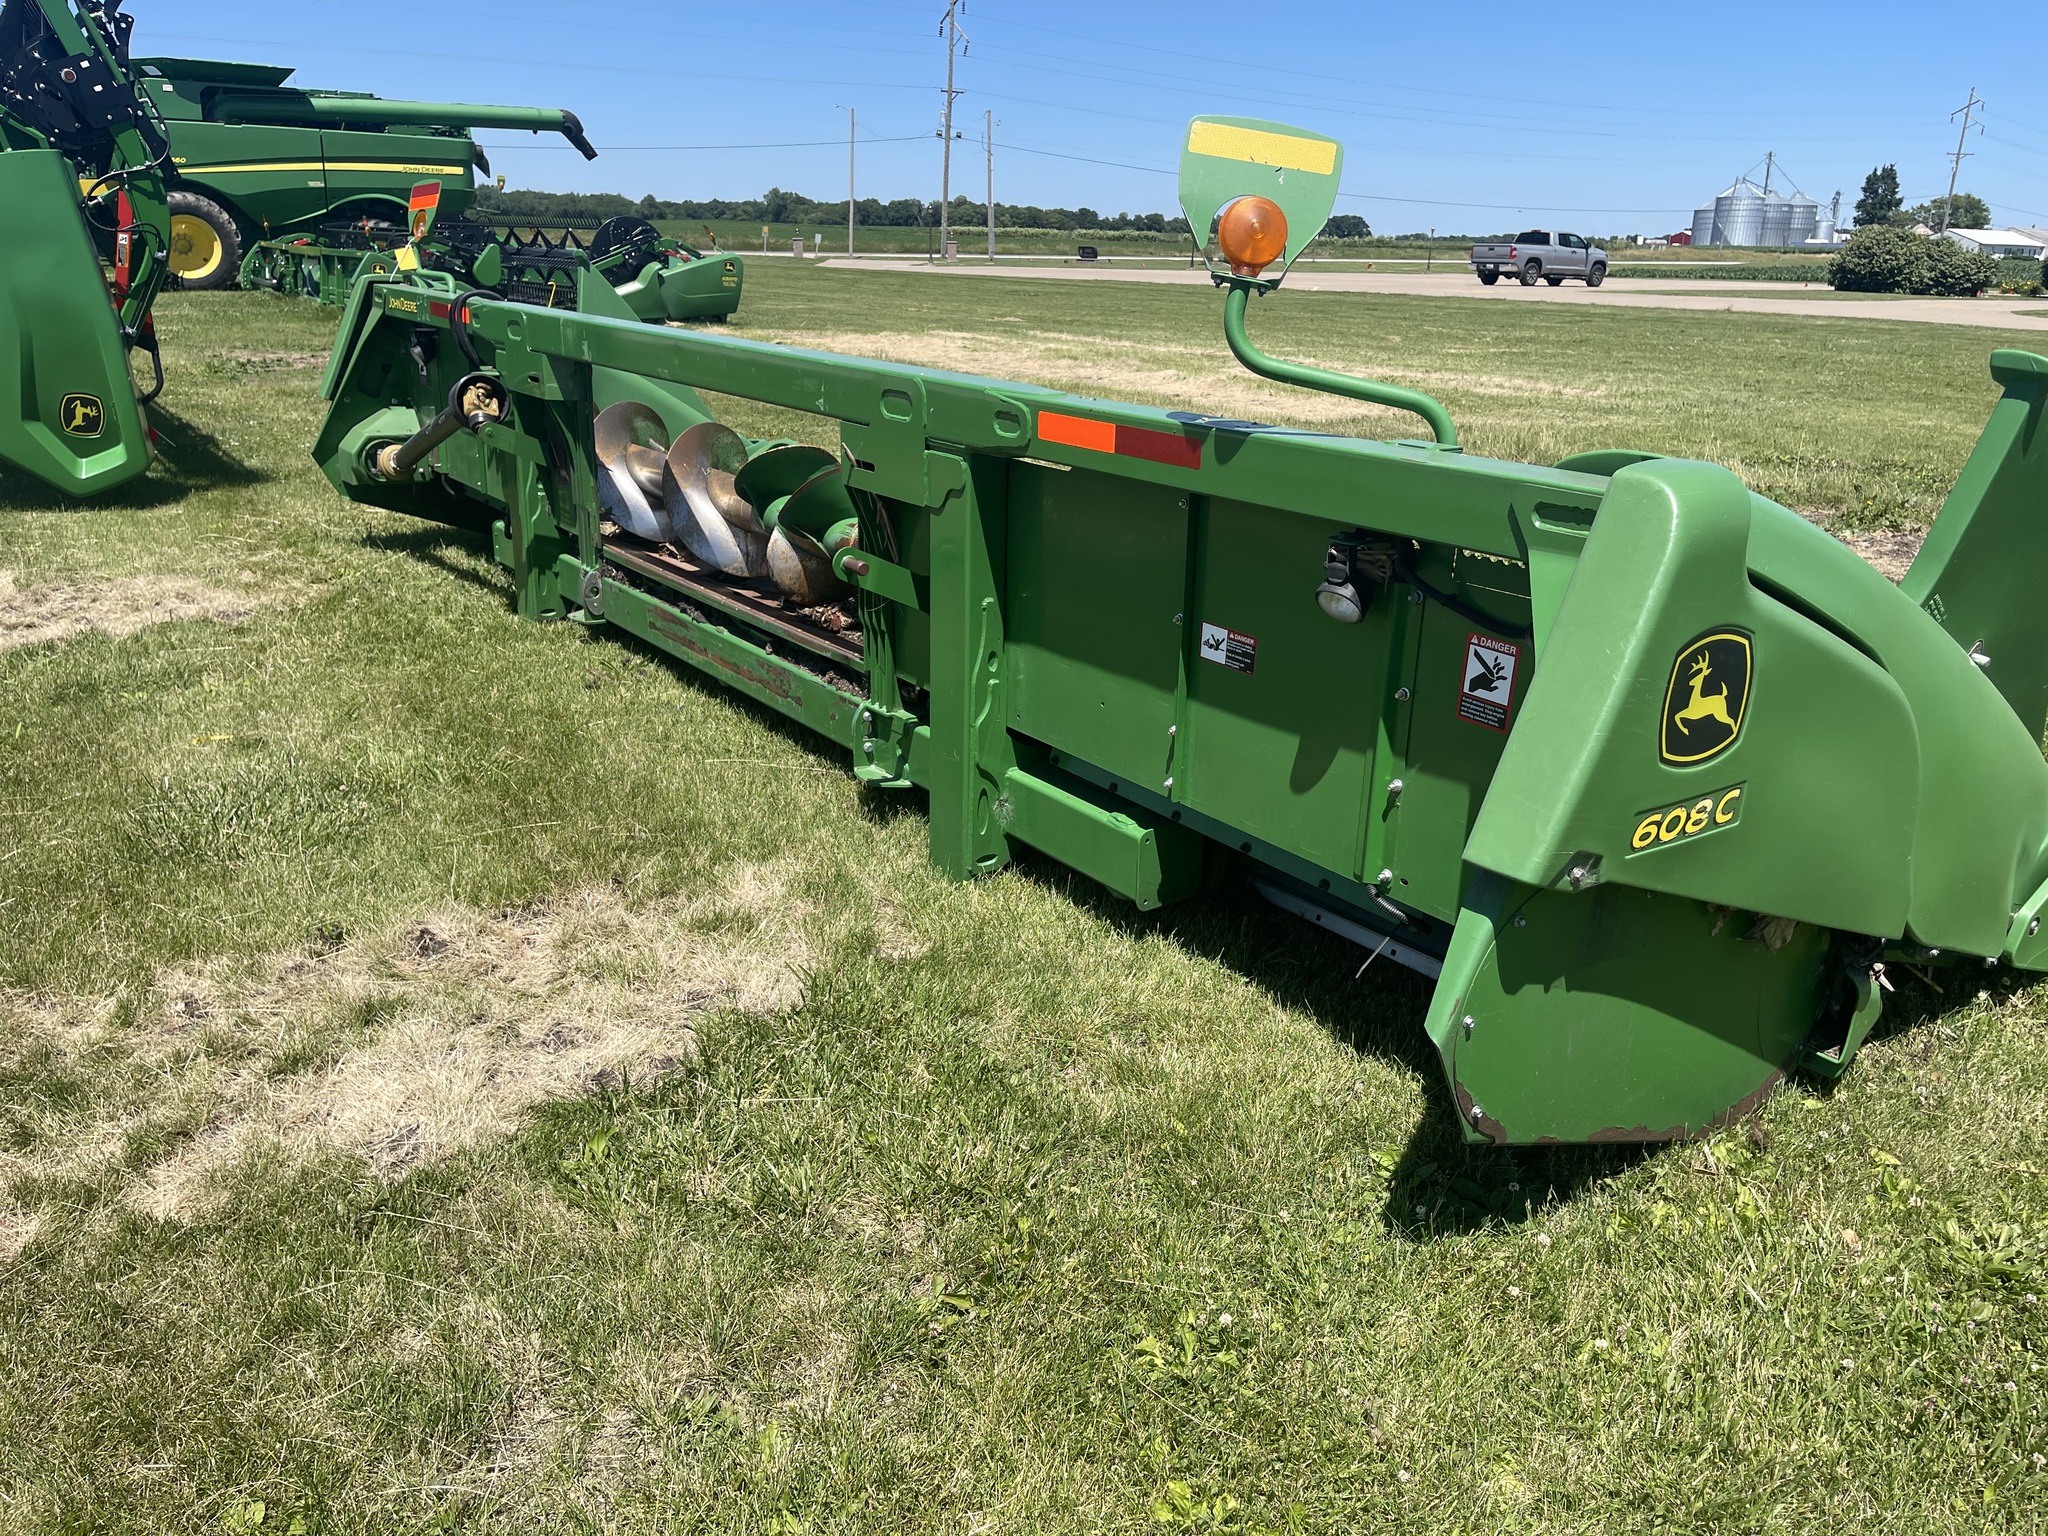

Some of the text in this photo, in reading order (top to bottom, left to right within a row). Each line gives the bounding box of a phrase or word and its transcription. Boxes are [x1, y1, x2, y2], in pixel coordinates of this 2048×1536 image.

[389, 296, 401, 310] JOHN
[400, 297, 418, 313] DEERE
[1234, 633, 1255, 646] DANGER
[1480, 638, 1517, 655] DANGER
[1631, 786, 1742, 852] 608C
